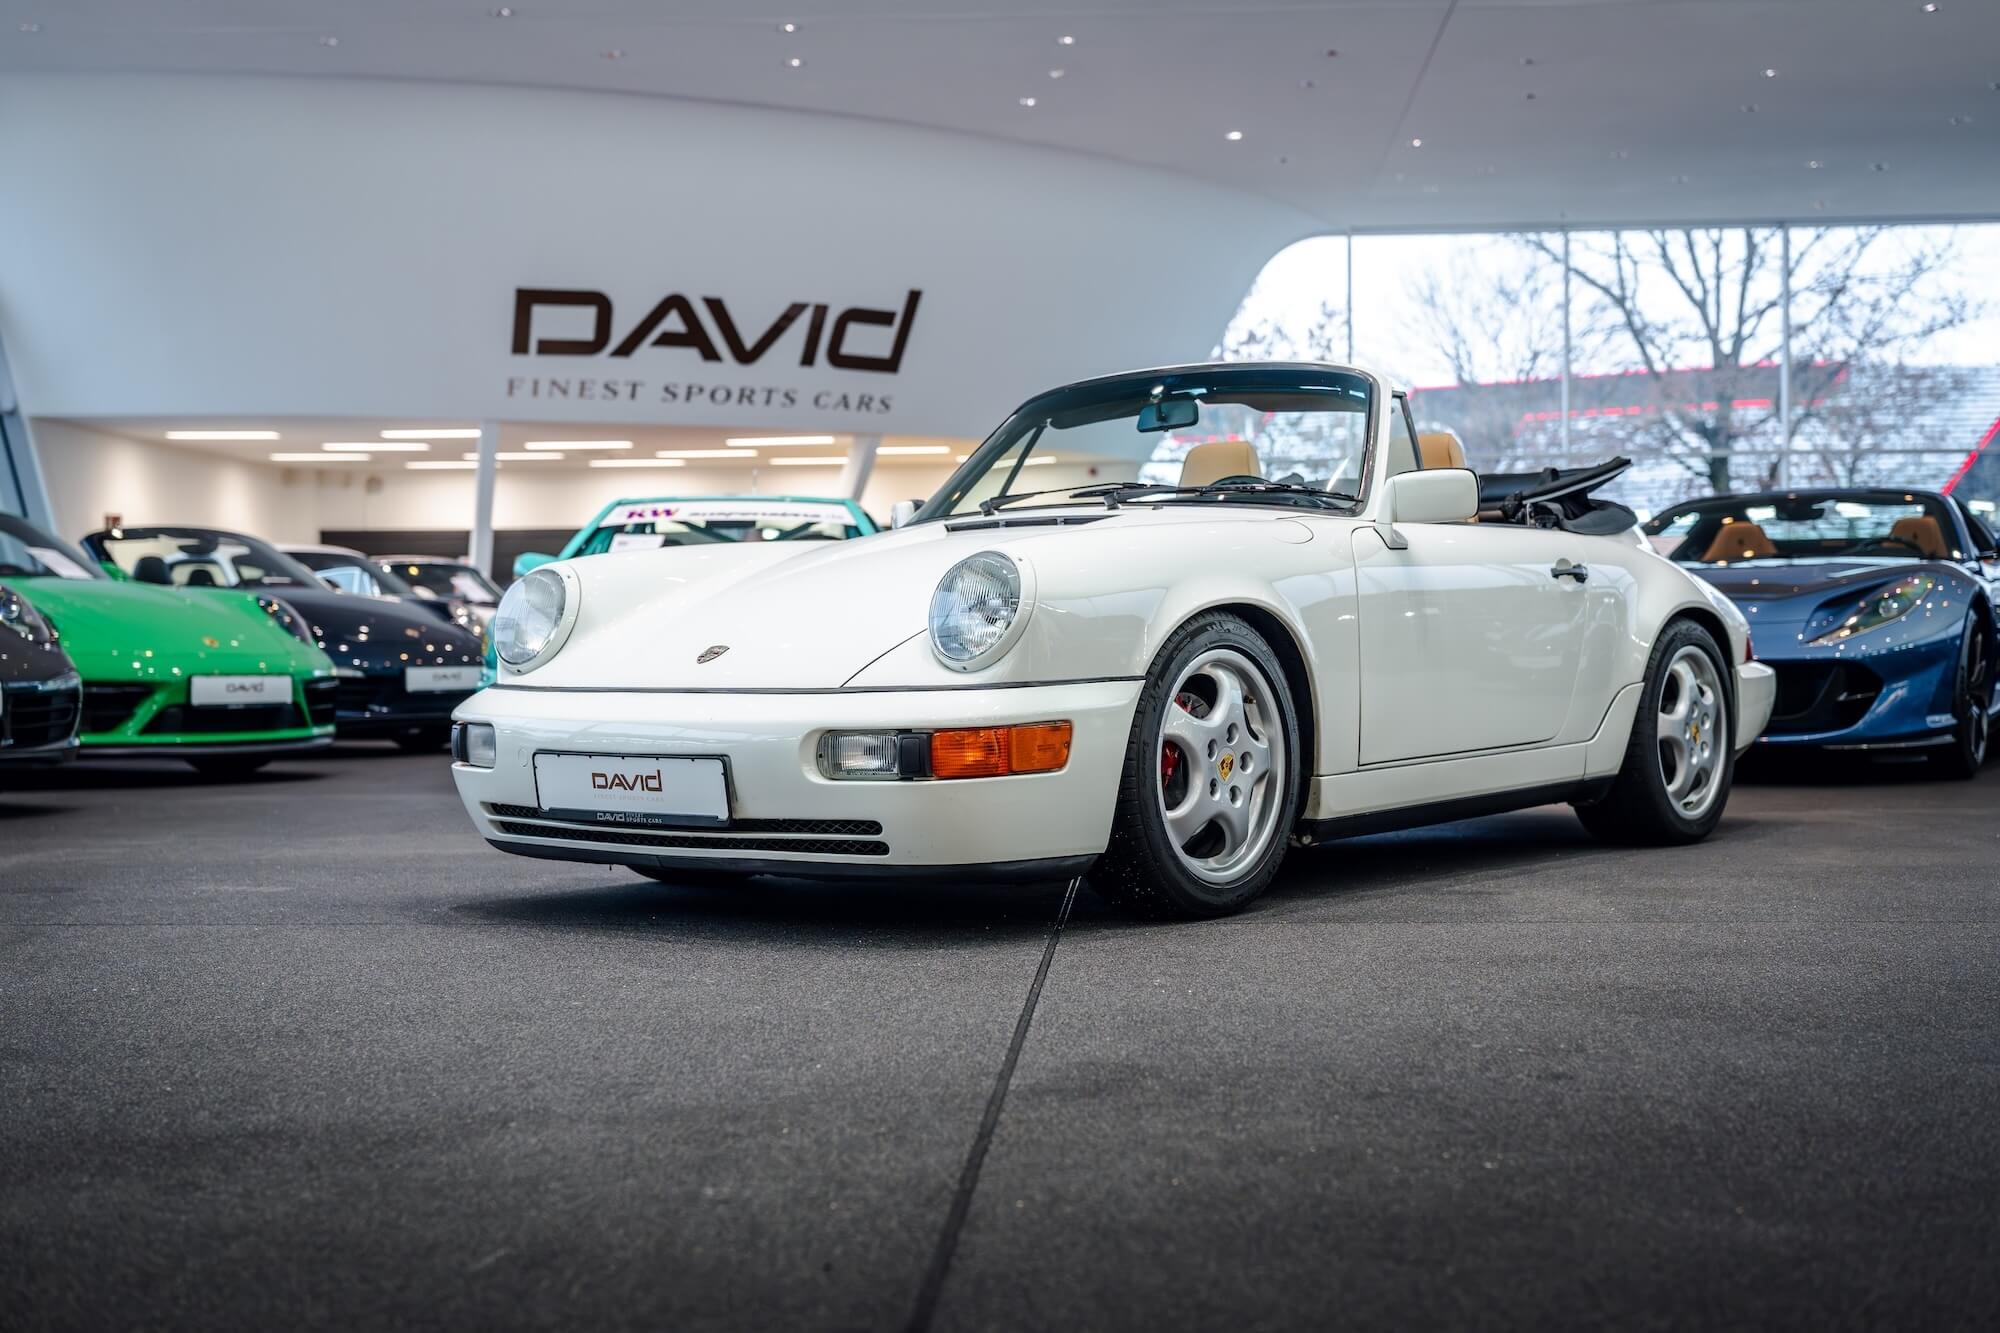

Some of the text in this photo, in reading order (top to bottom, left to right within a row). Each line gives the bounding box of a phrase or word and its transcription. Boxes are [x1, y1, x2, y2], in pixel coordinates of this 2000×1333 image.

[507, 377, 894, 414] FINEST SPORTS CARS
